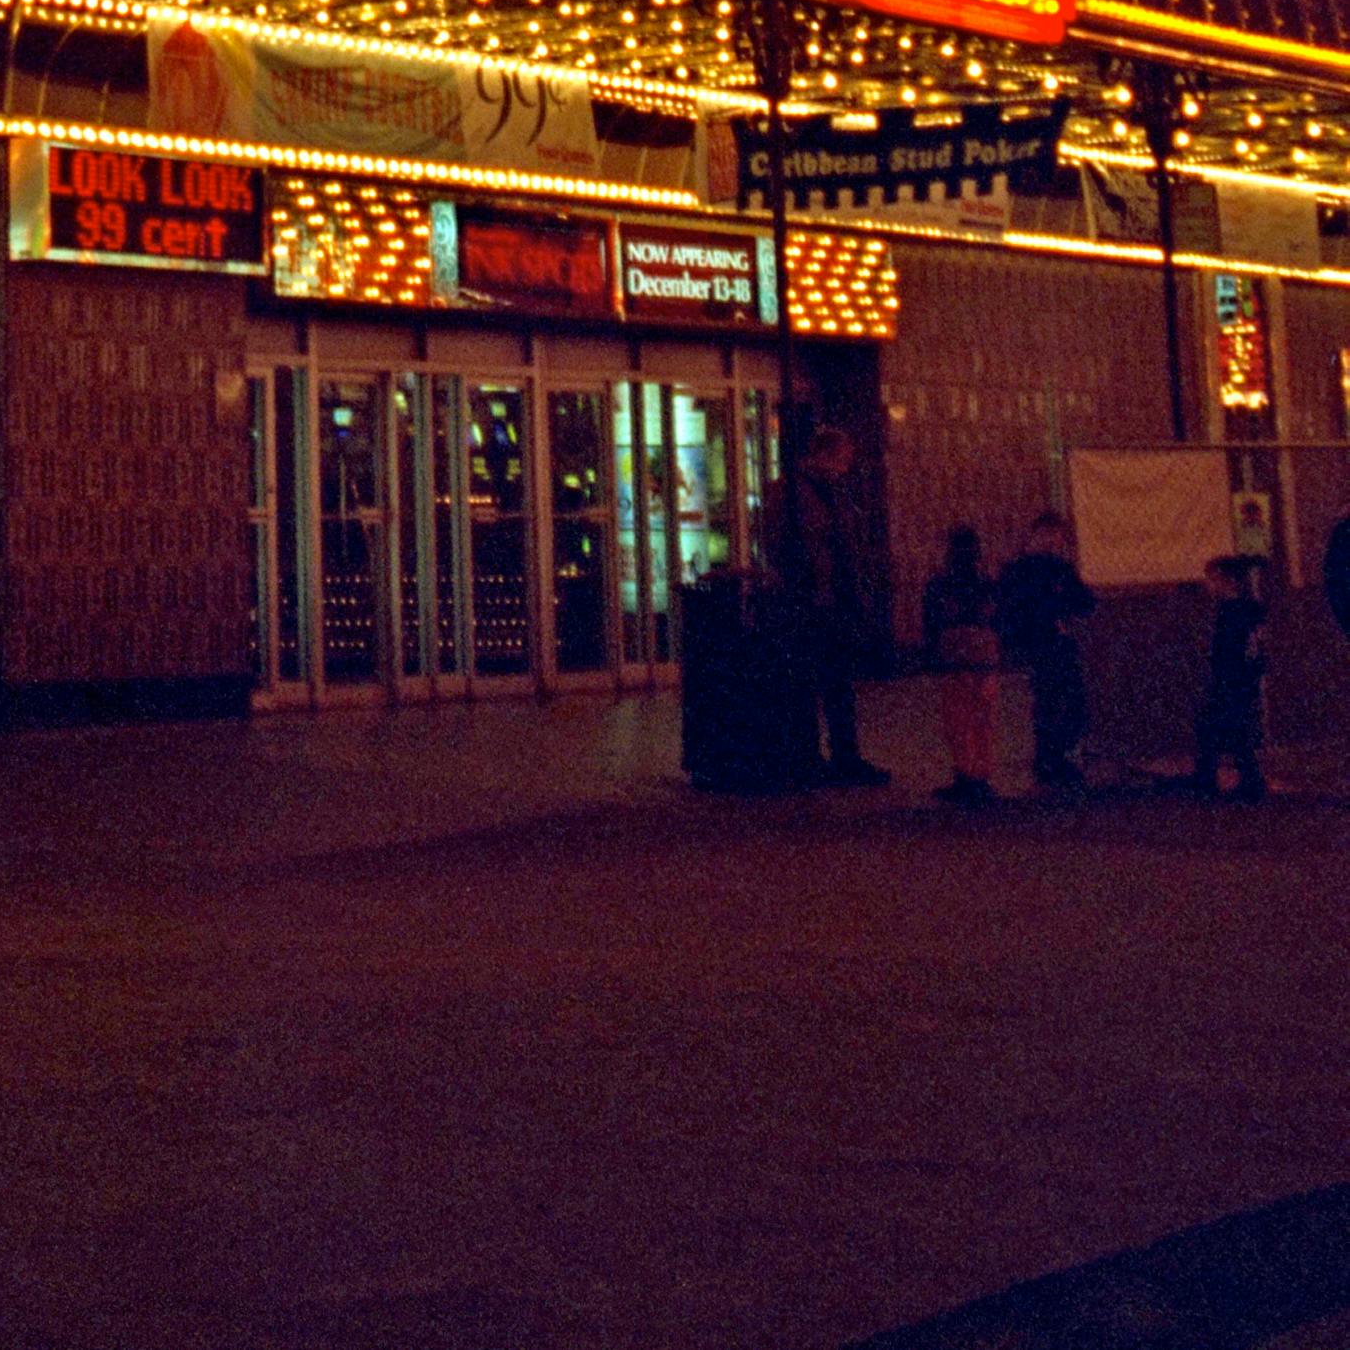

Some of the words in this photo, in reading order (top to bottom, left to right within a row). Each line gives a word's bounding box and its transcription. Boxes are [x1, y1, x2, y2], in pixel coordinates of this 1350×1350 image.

[750, 149, 878, 178] Cribbean
[890, 145, 958, 171] Stud
[964, 137, 1040, 165] Poker
[48, 147, 146, 202] LOOK
[161, 158, 254, 212] LOOK
[76, 199, 127, 251] 99
[142, 217, 228, 259] cent
[627, 241, 669, 265] NOW
[671, 244, 750, 272] APPEARING
[627, 266, 711, 300] December
[712, 274, 752, 304] 13-18
